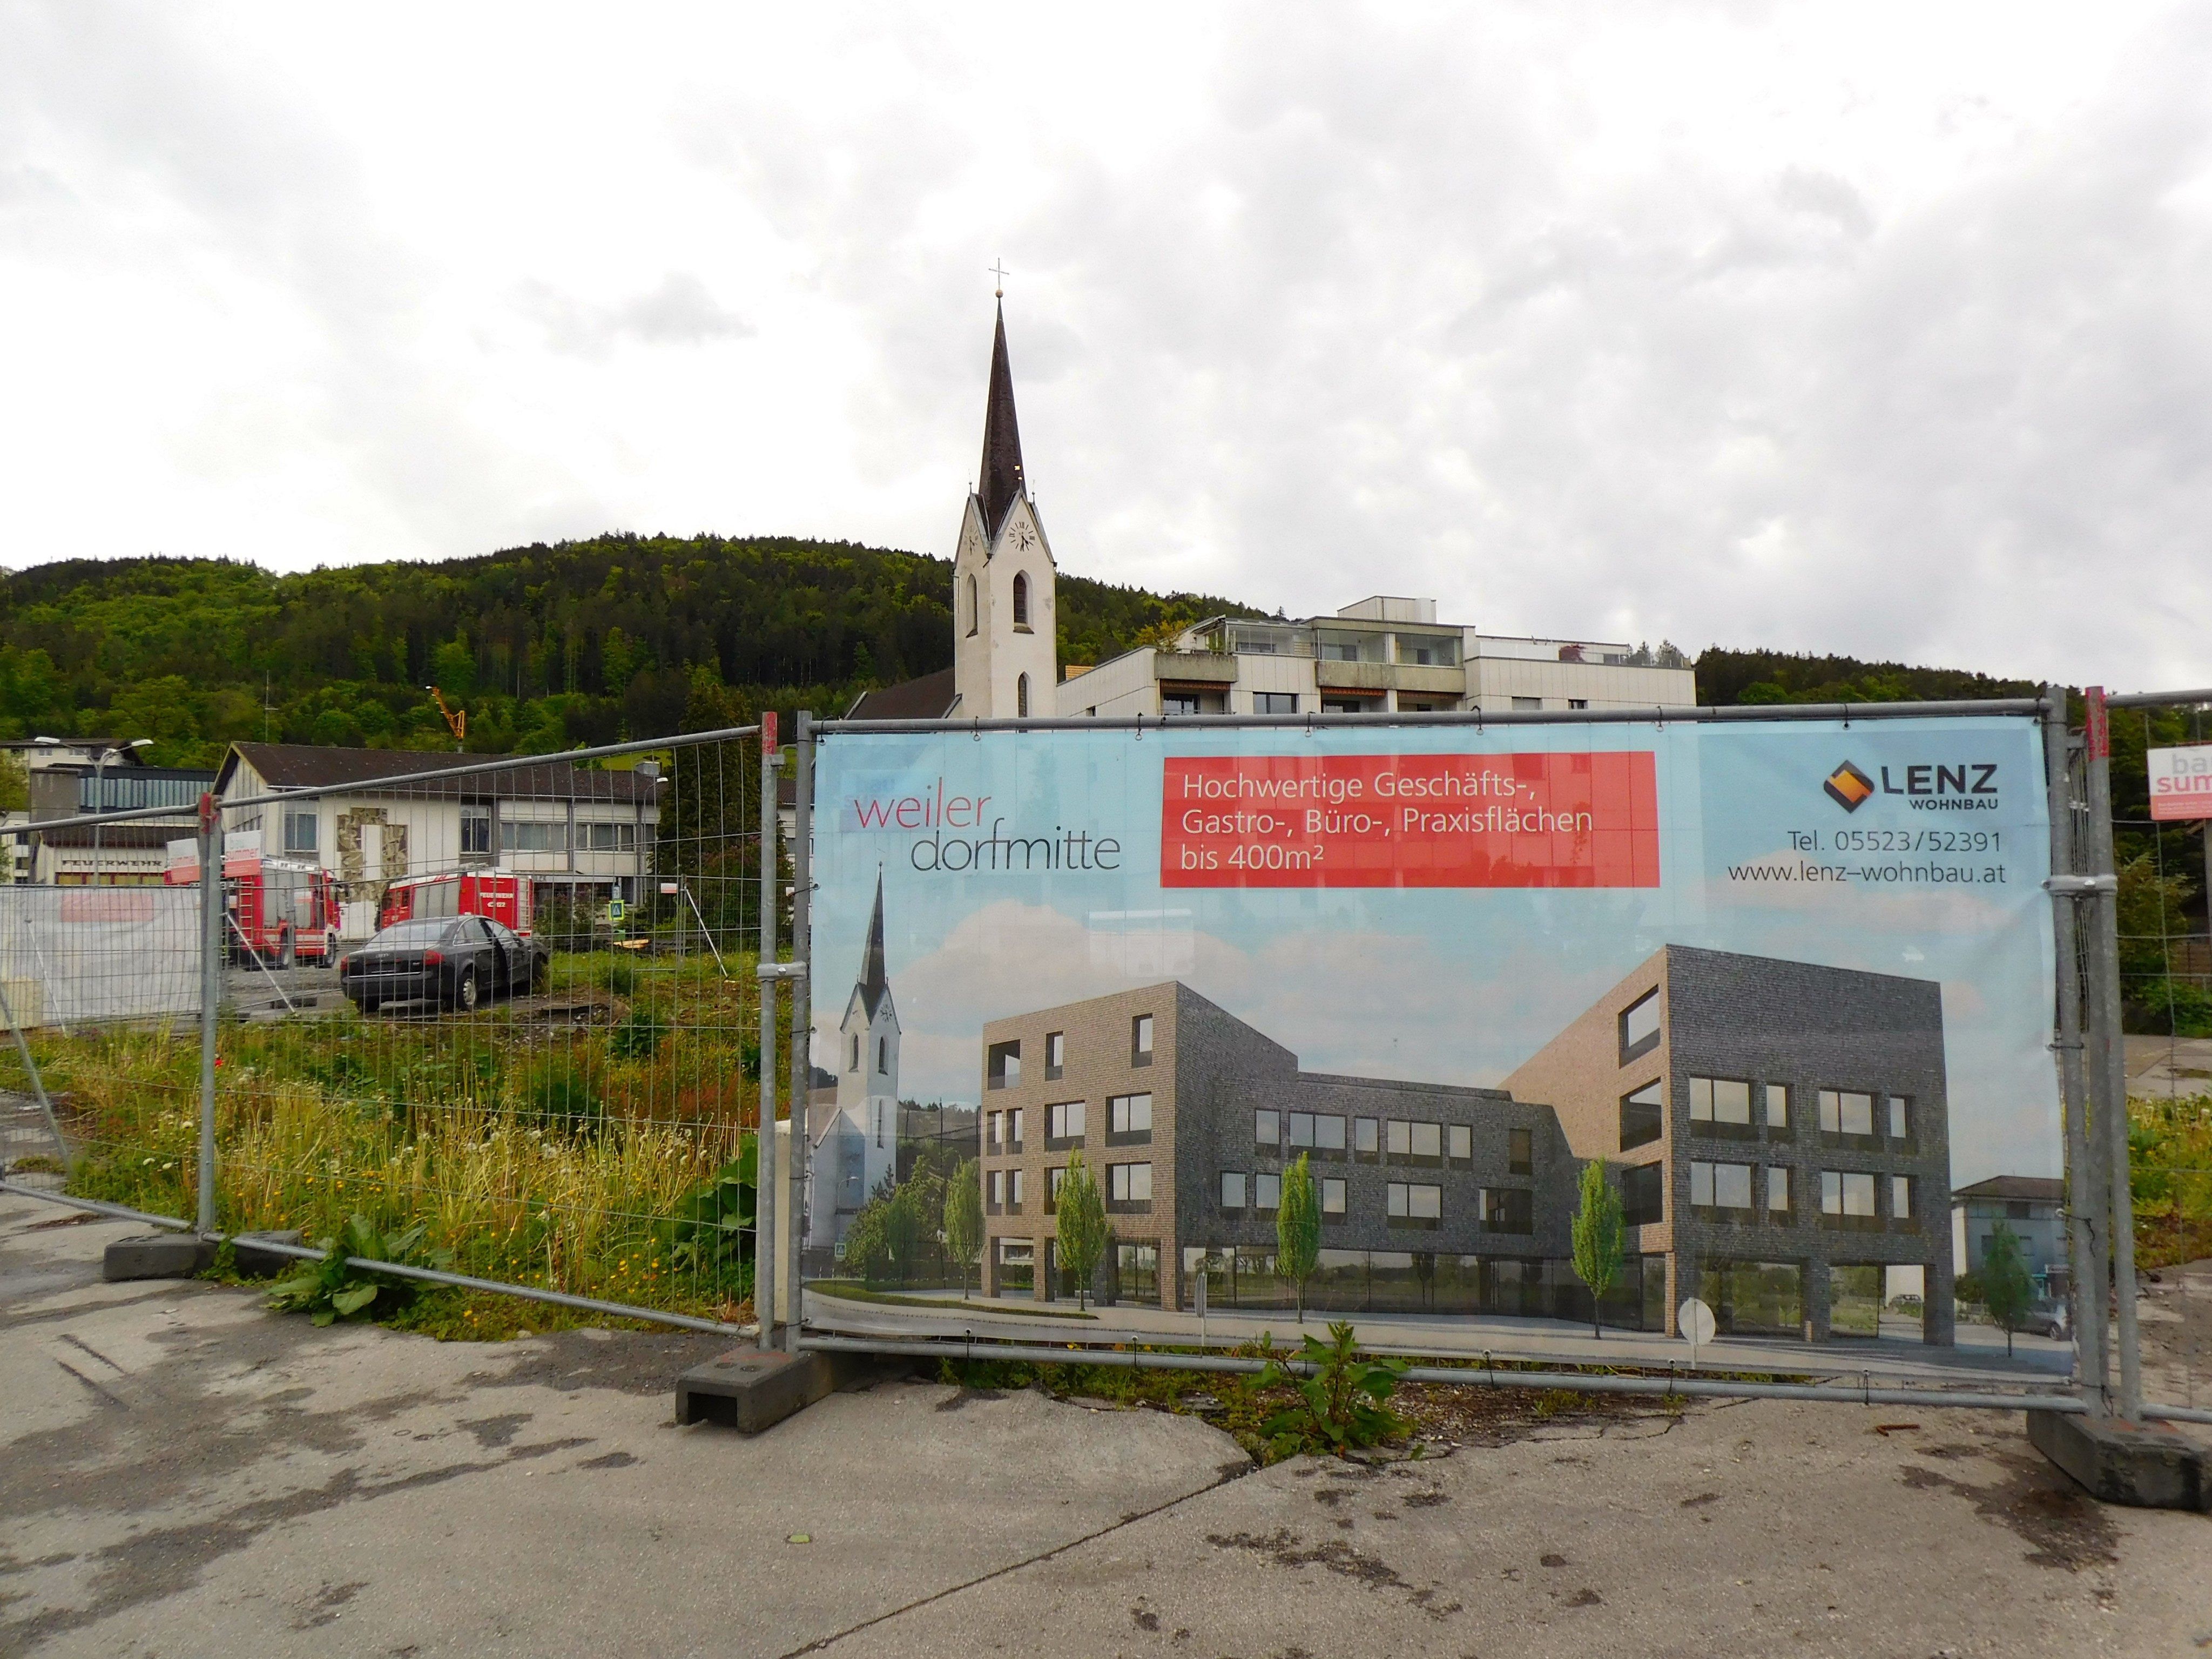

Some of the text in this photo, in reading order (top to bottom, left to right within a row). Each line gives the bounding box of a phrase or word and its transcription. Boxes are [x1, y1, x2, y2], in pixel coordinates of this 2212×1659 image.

[2173, 753, 2212, 774] ba
[1183, 770, 1535, 804] Hochwertige Geschäfts-,
[1881, 764, 1998, 794] LENZ
[854, 776, 992, 828] weiler
[1909, 798, 1999, 810] WOHNBAU
[1183, 806, 1593, 838] Gastro-, Büro-, Praxisflächen
[911, 818, 1121, 872] dorfmitte
[1787, 830, 2001, 852] Tel. 05523/52391
[1181, 844, 1324, 870] bis 400m²
[1728, 861, 2006, 882] www.lenz-wohnbau.at
